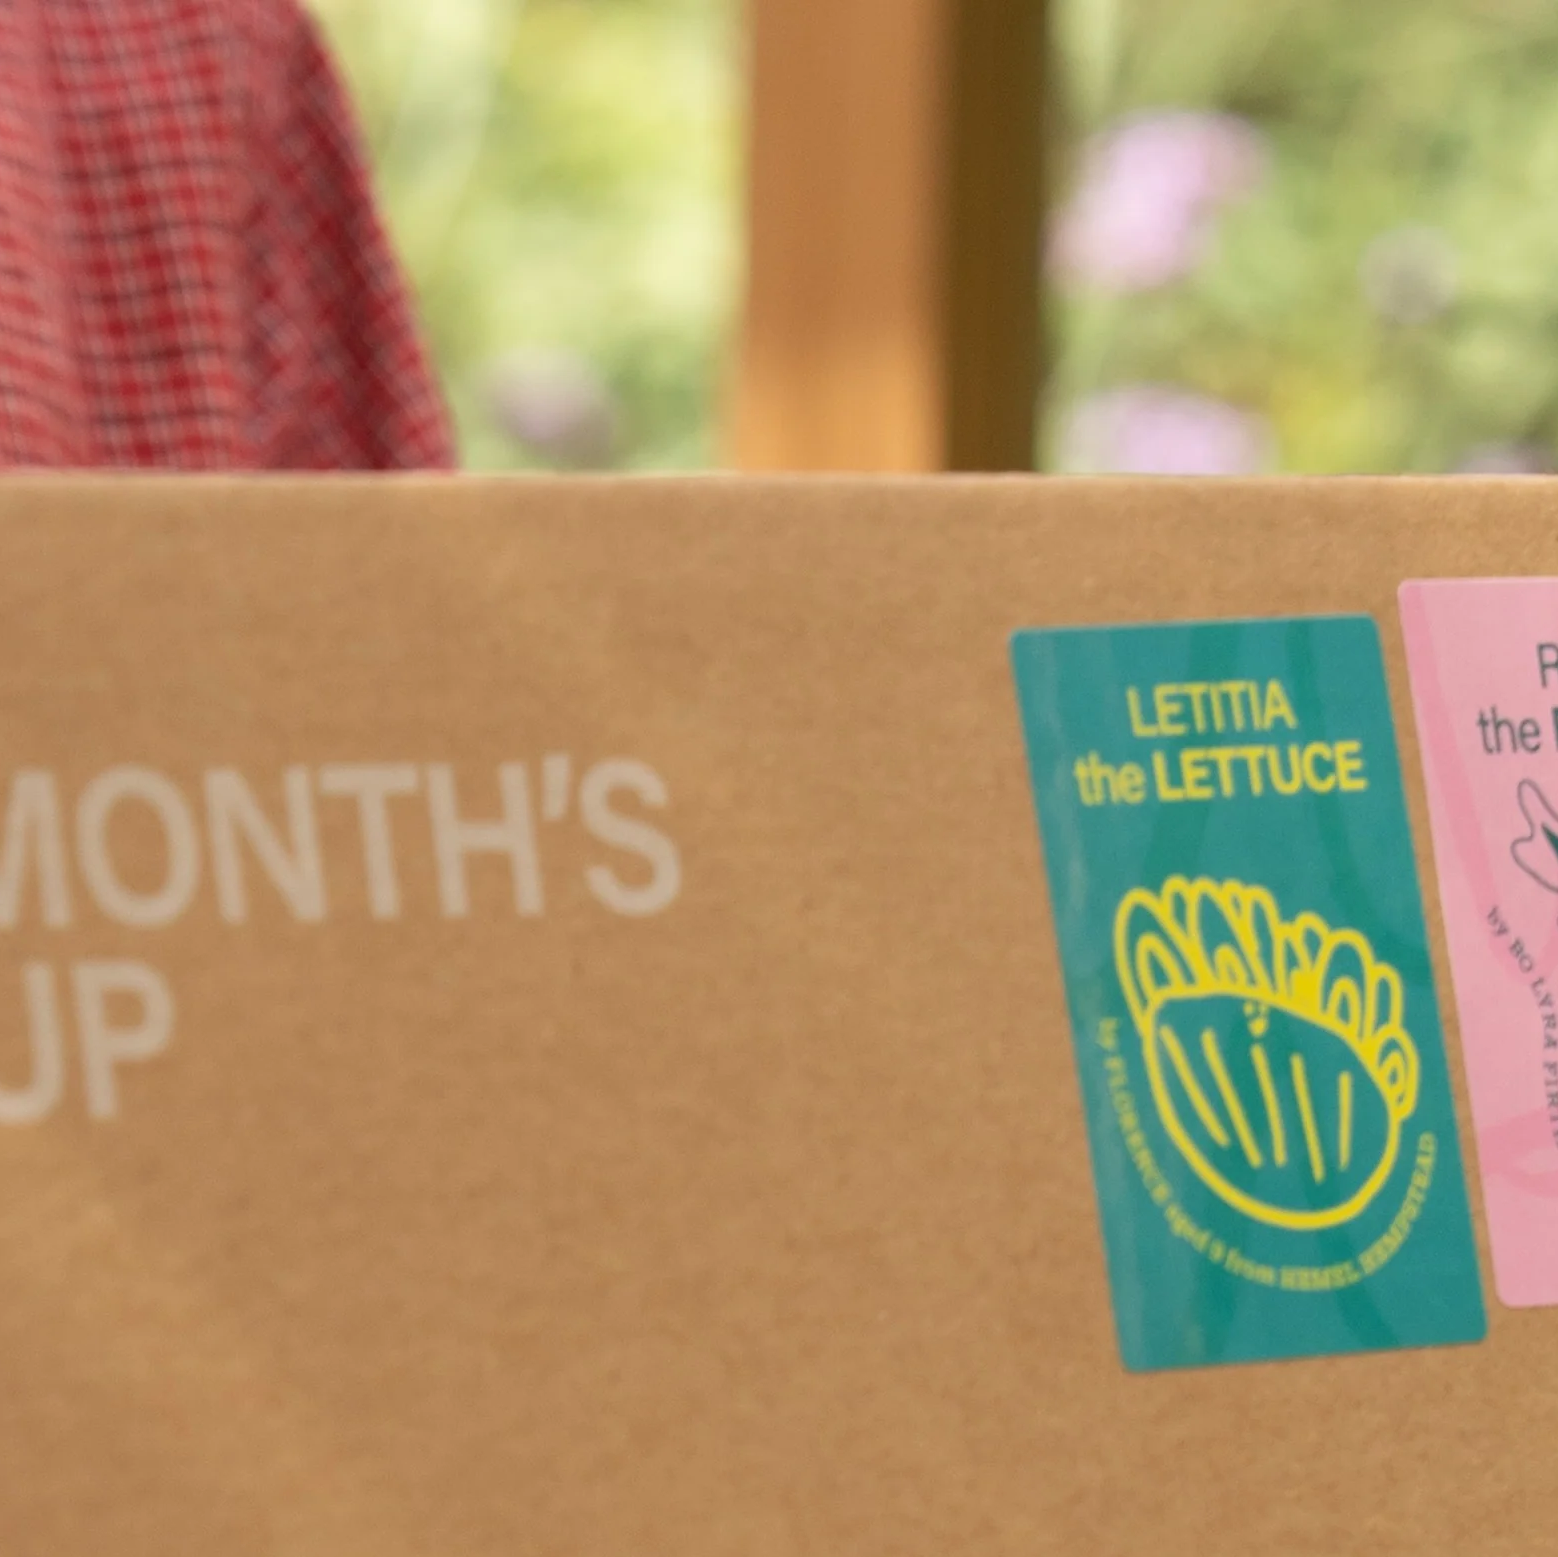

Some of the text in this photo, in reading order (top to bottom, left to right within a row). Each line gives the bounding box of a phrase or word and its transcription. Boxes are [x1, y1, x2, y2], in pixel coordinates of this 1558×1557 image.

[1126, 678, 1298, 739] LETITIA
[1476, 705, 1541, 754] the
[1073, 740, 1369, 806] the LETTUCE
[1487, 905, 1509, 937] by
[1508, 938, 1534, 973] BO
[1530, 977, 1558, 1050] LYRA
[1165, 1202, 1212, 1253] aged
[1224, 1247, 1275, 1287] from
